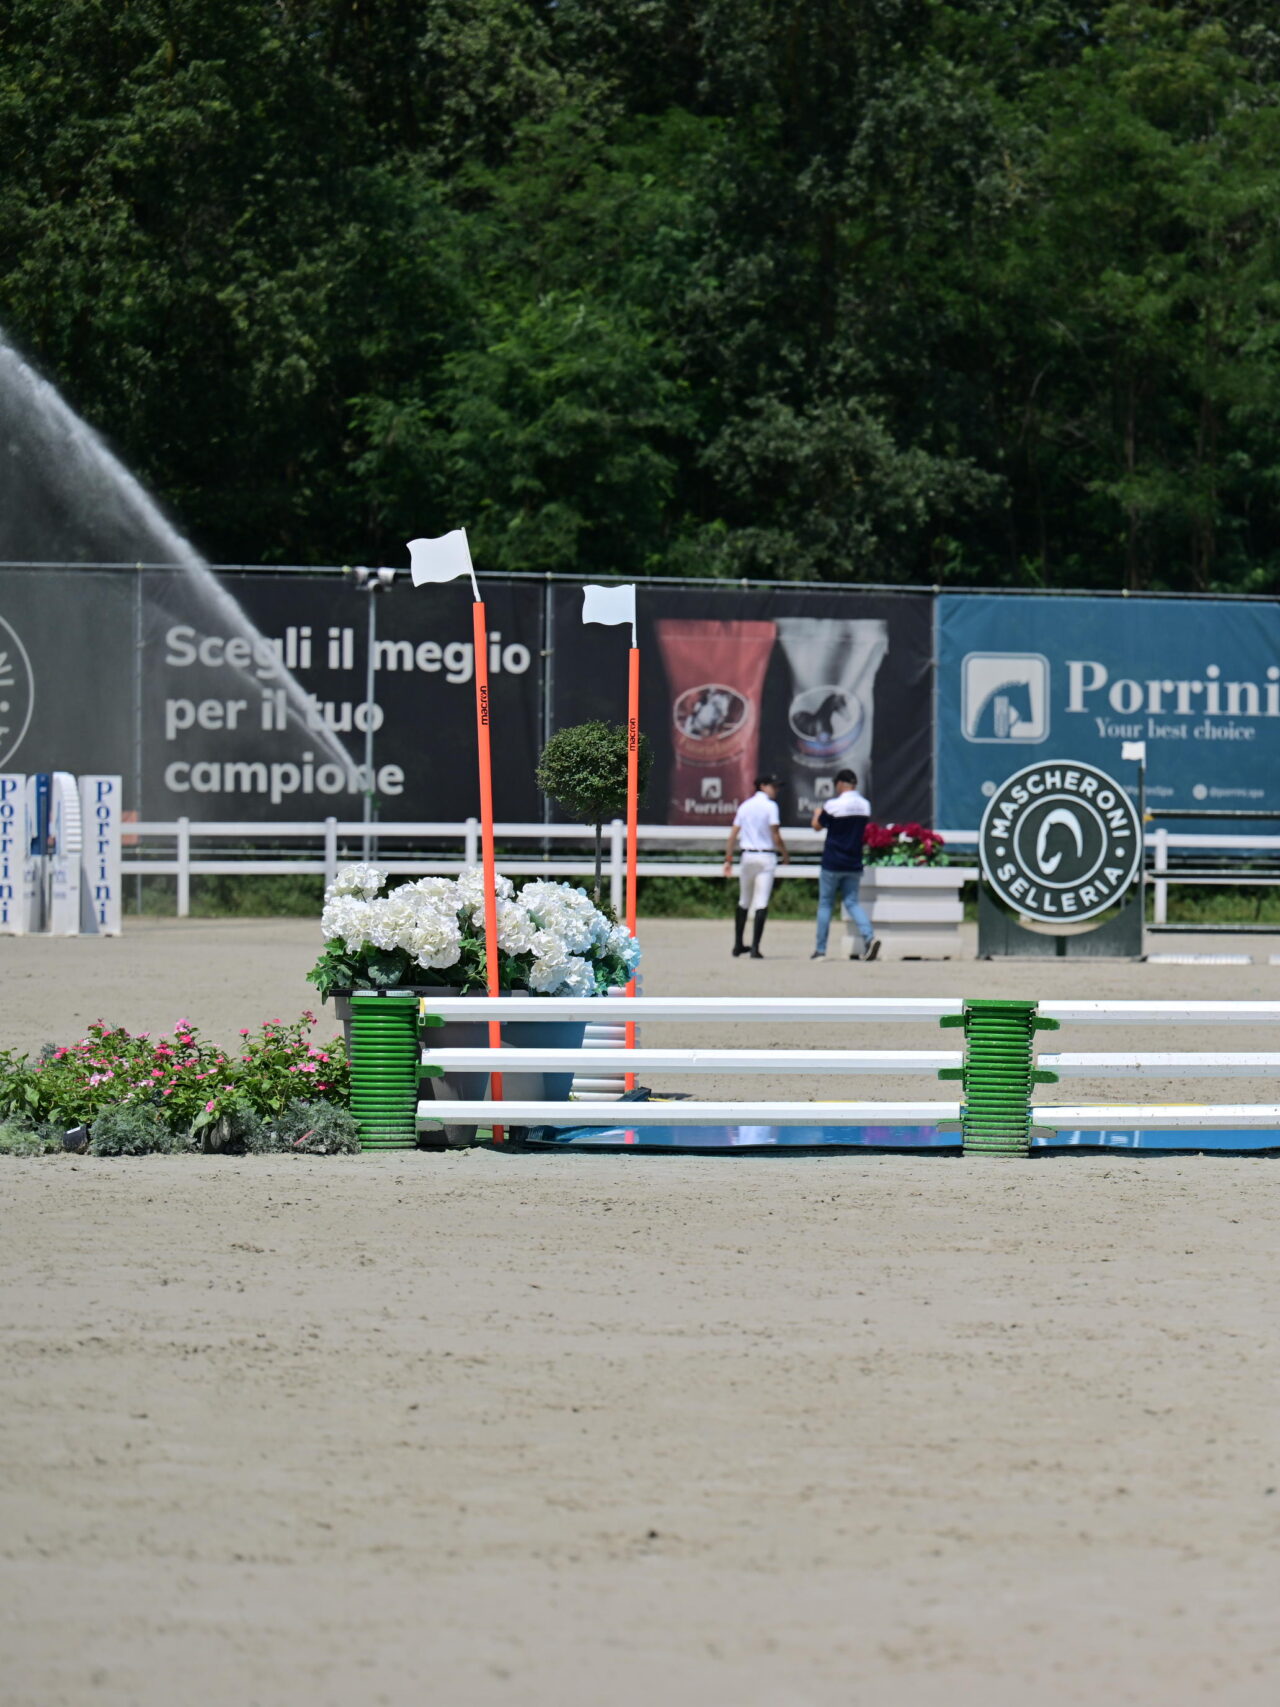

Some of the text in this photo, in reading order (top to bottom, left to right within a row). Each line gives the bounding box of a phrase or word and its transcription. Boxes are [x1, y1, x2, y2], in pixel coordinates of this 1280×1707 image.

[165, 625, 531, 684] Scegli il megio
[165, 688, 385, 741] per il tuo
[480, 685, 488, 726] macron
[1094, 716, 1256, 741] Your best choice
[164, 751, 405, 805] campione
[990, 769, 1132, 840] MASCHERONI
[0, 779, 17, 925] Porrini
[94, 781, 113, 926] Porrini
[996, 863, 1125, 913] SELLERIA
